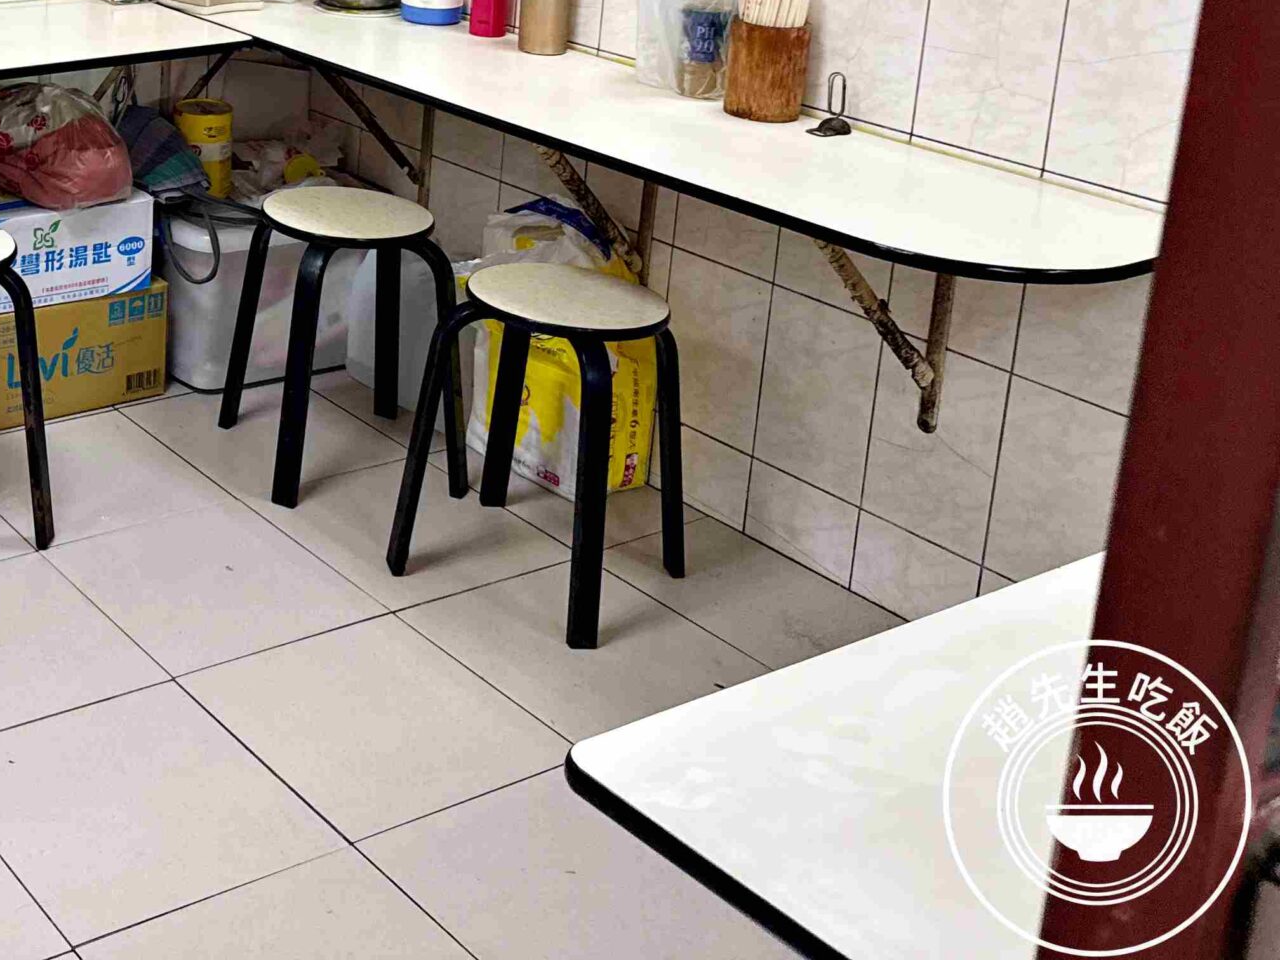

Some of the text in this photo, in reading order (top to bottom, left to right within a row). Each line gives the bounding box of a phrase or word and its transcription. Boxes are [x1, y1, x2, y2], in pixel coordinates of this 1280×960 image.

[696, 25, 715, 39] PH
[10, 241, 112, 277] 彎形湯匙
[118, 241, 144, 252] 6000
[6, 327, 116, 390] Lvi 優活
